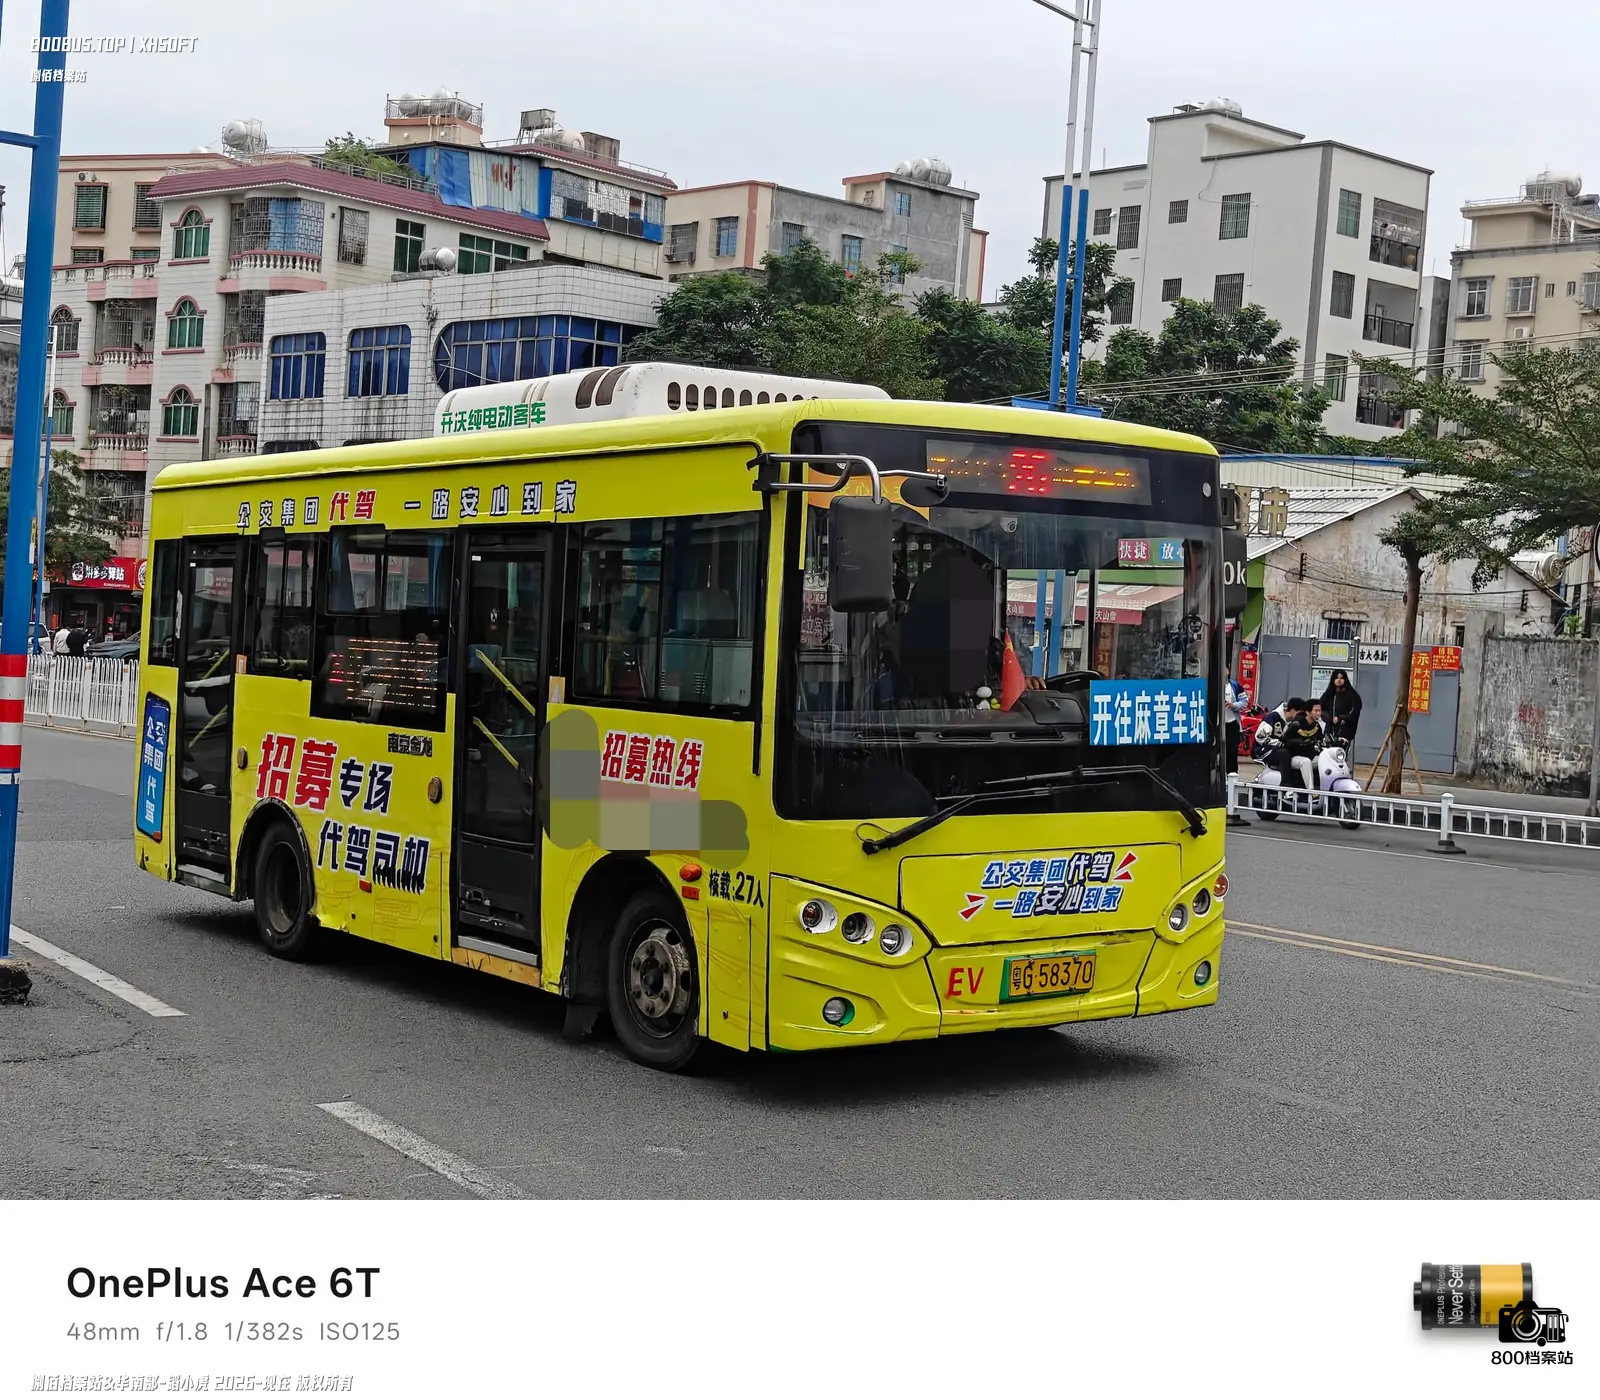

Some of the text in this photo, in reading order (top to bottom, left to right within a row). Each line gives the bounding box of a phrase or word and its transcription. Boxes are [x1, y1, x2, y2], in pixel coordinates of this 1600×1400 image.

[440, 401, 546, 434] 开沃纯电动客车
[404, 479, 577, 520] 一路安心到家
[1119, 541, 1147, 559] 快捷
[1092, 690, 1205, 745] 开往麻章车站
[257, 732, 394, 816] 招募专场
[600, 729, 704, 792] 招募热线
[316, 818, 432, 895] 代驾司机
[981, 851, 1115, 889] 公交集团代驾
[993, 884, 1123, 918] 一路安心到家
[947, 966, 985, 997] EV
